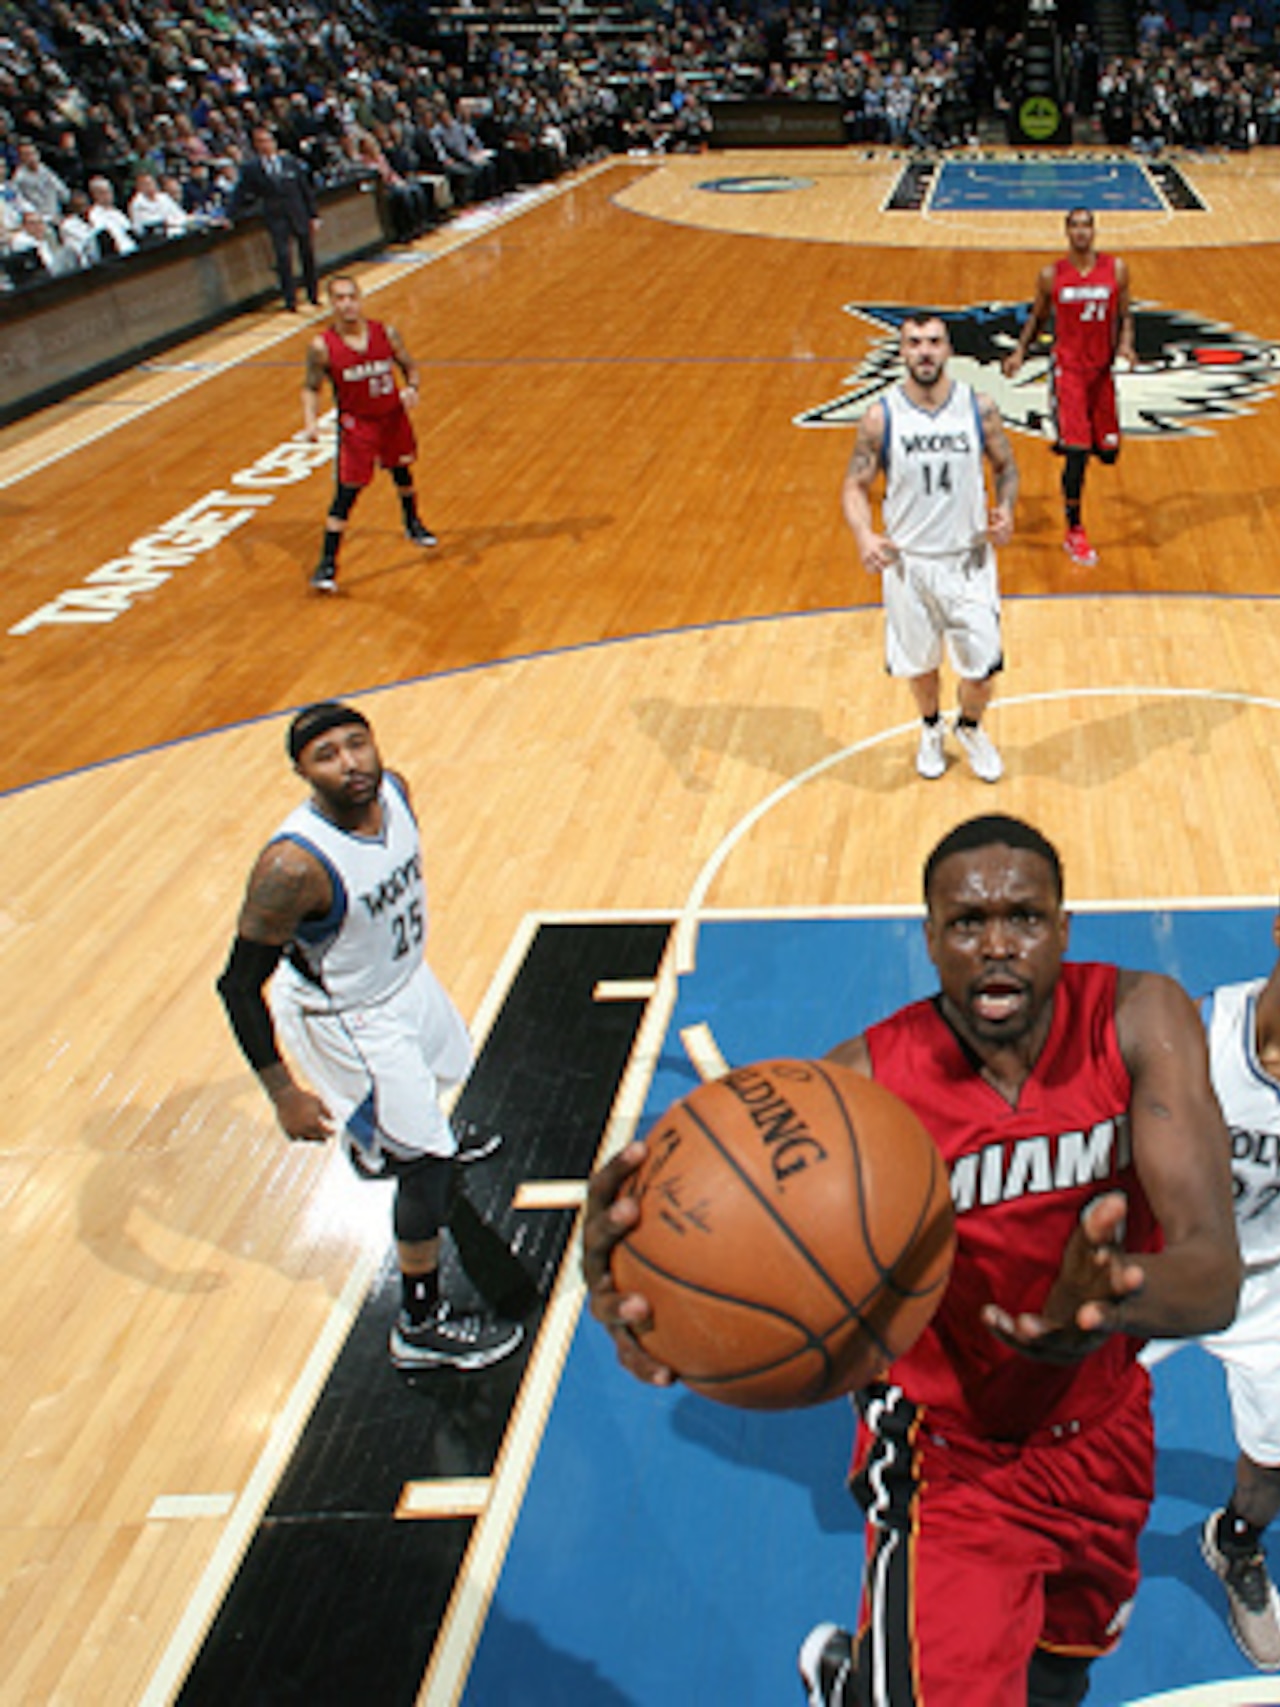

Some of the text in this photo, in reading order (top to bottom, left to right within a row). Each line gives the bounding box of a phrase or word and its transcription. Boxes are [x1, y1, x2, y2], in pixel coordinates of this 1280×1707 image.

[922, 461, 952, 496] 14
[8, 489, 276, 636] TARGET
[391, 899, 423, 962] 25
